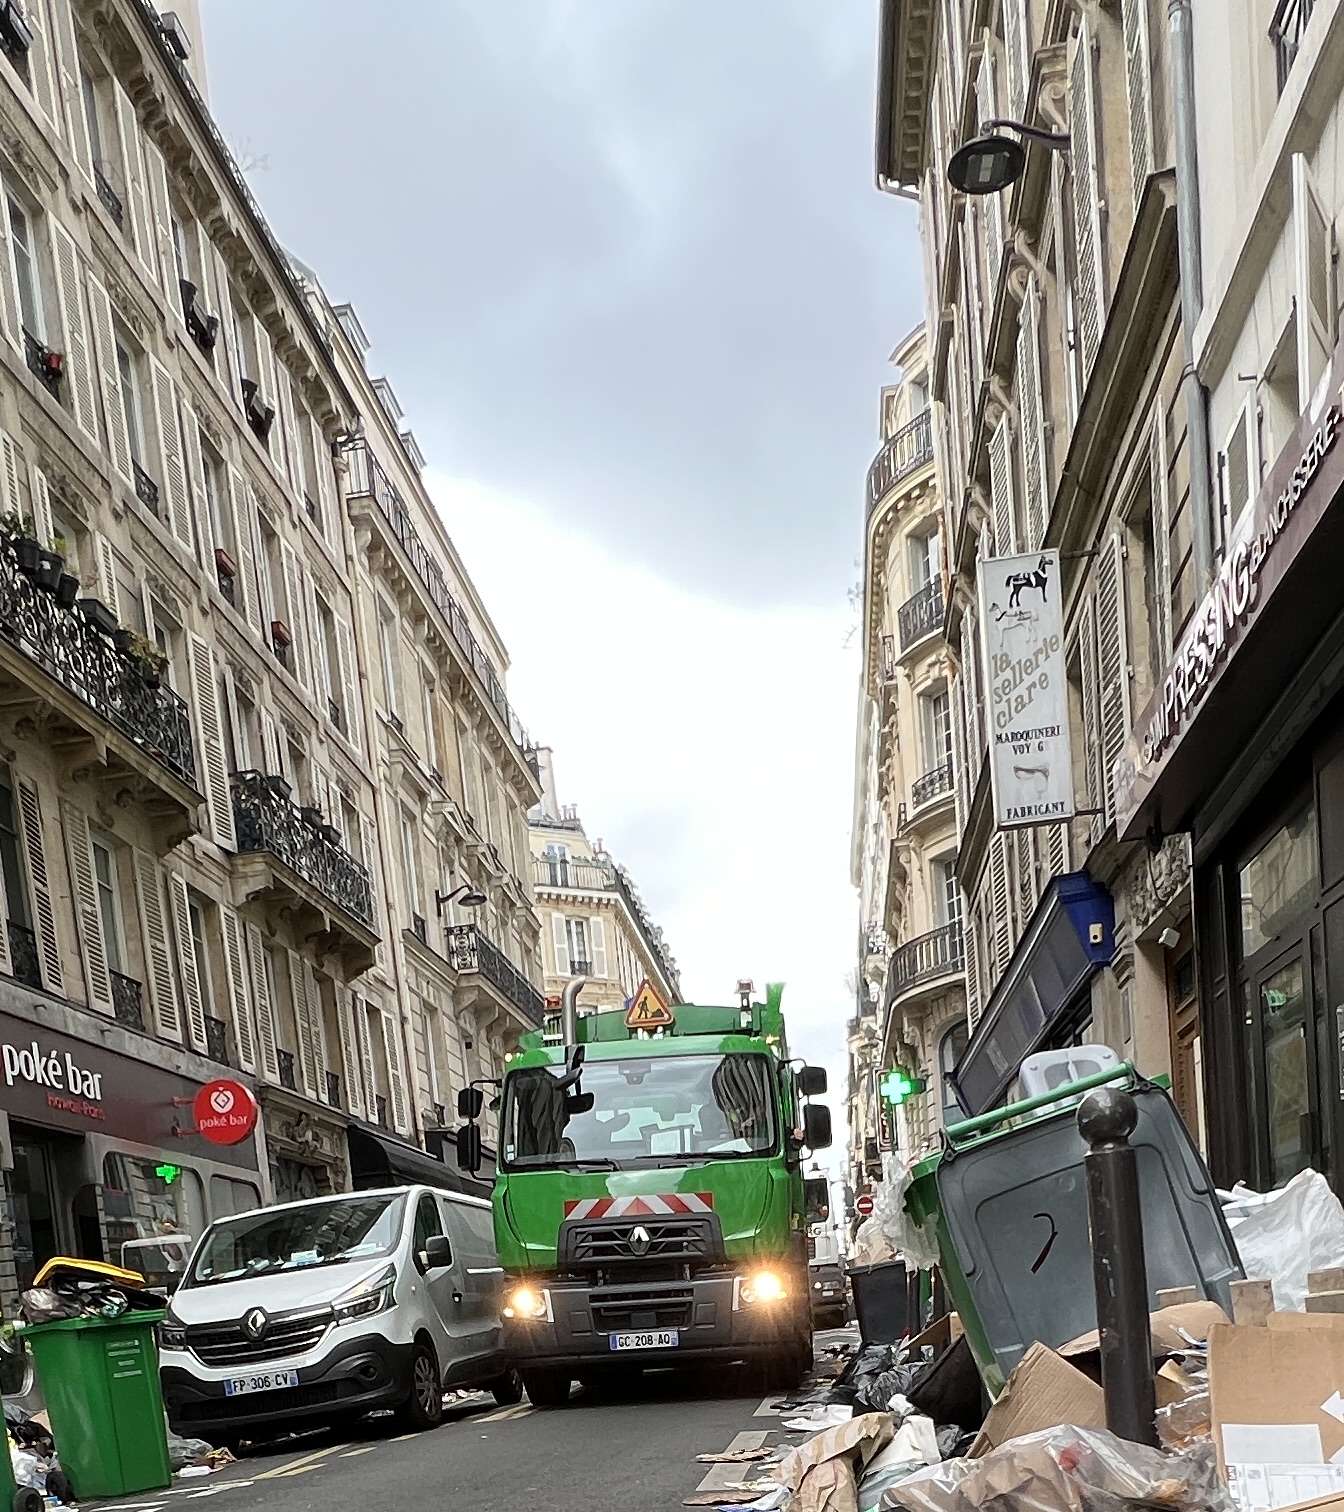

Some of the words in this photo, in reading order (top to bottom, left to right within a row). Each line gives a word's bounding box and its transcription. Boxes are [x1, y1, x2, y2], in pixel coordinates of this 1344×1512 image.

[1163, 541, 1250, 722] PRESSING
[991, 651, 1012, 680] la
[992, 634, 1060, 705] sellerie
[995, 671, 1050, 730] clare
[1006, 801, 1066, 820] FABRICANT
[1, 1041, 65, 1087] poké
[66, 1052, 103, 1102] bar
[199, 1115, 227, 1130] poké
[229, 1114, 248, 1127] bar
